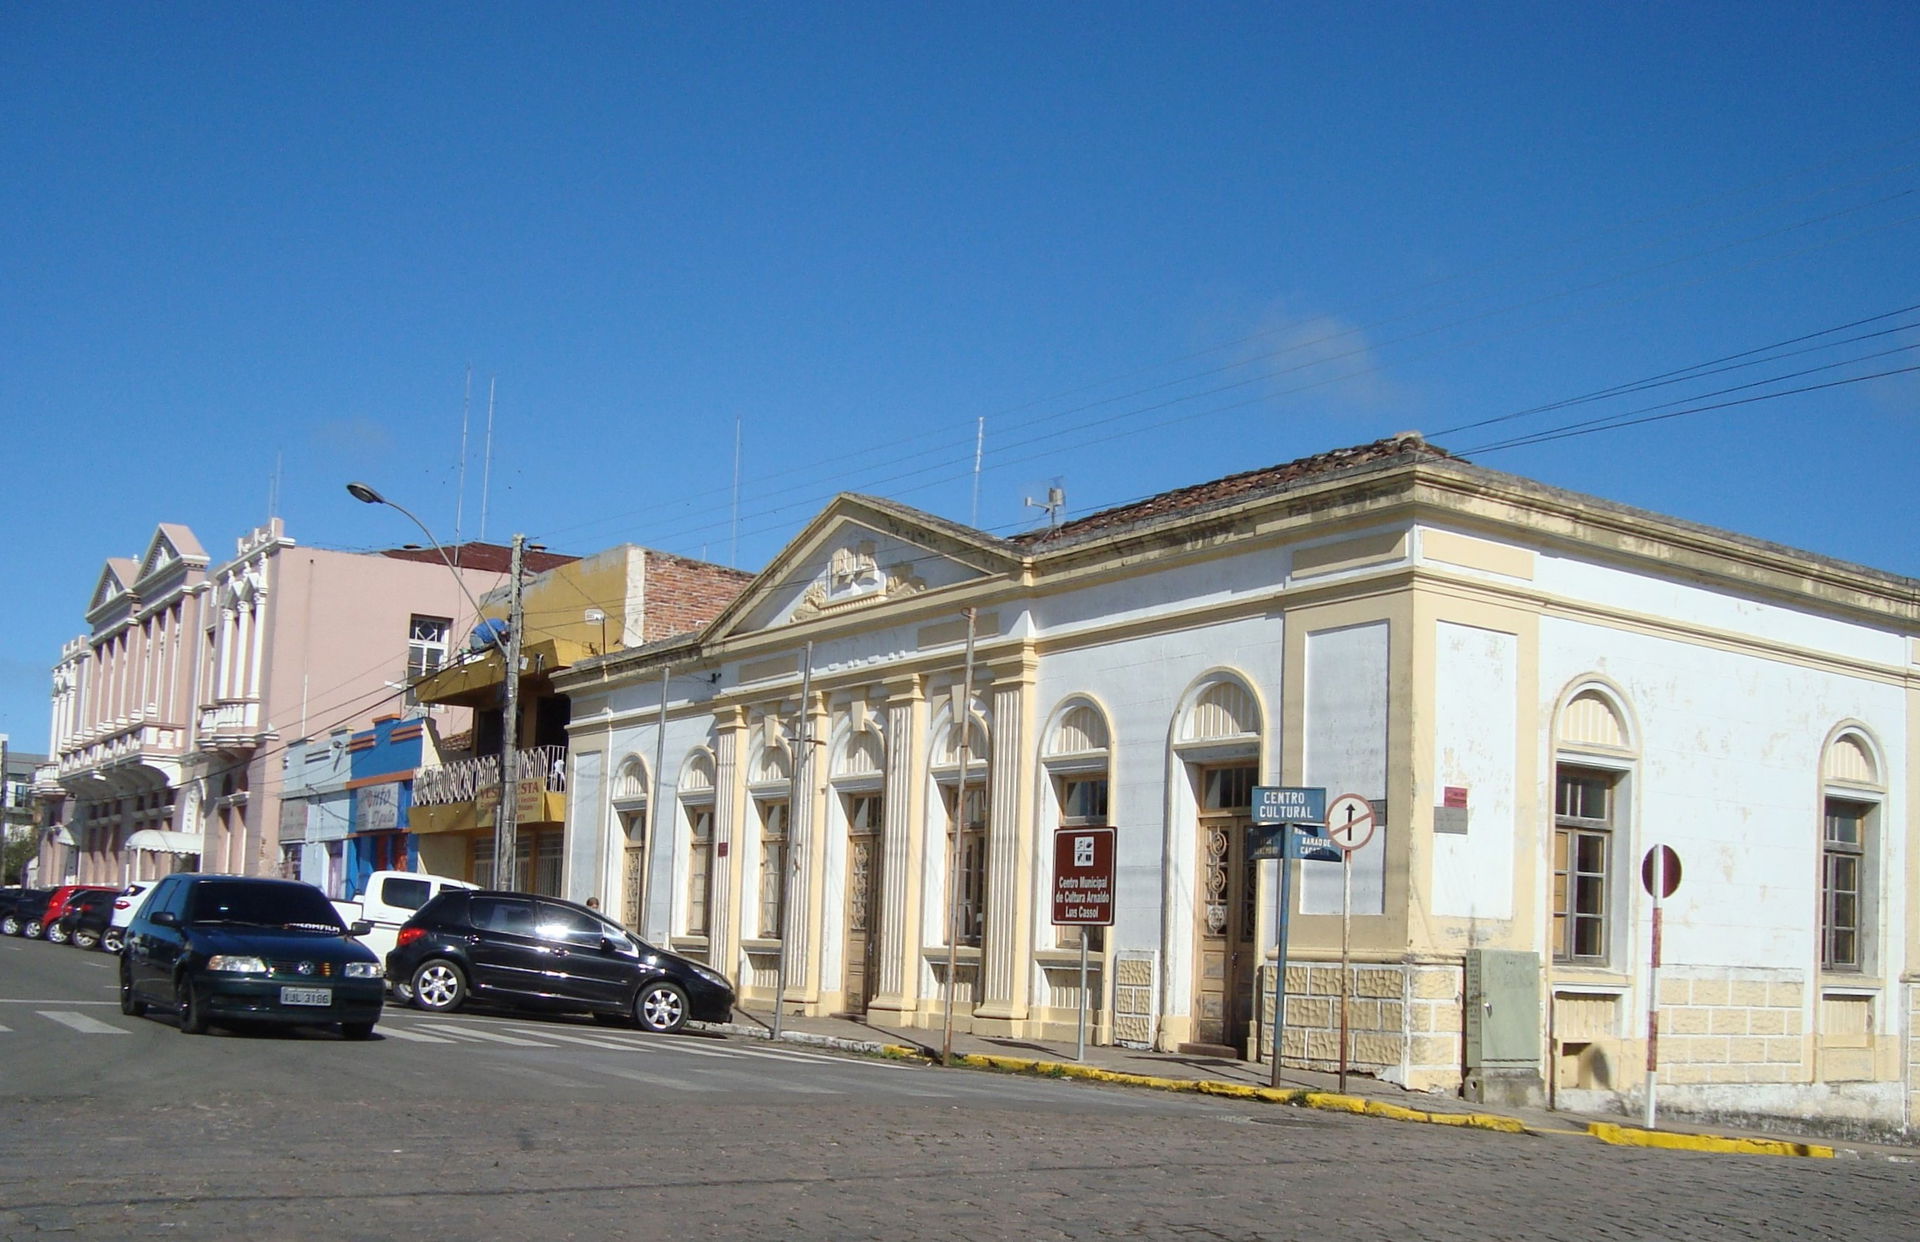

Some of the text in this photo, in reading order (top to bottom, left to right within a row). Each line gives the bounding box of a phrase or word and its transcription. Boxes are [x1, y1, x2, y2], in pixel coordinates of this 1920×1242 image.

[1264, 792, 1305, 804] CENTRO
[1260, 806, 1314, 818] CULTURAL
[1059, 876, 1107, 891] Centro Municipal
[1056, 890, 1110, 903] de Cultura Arnaldo
[1079, 906, 1099, 918] Cassol
